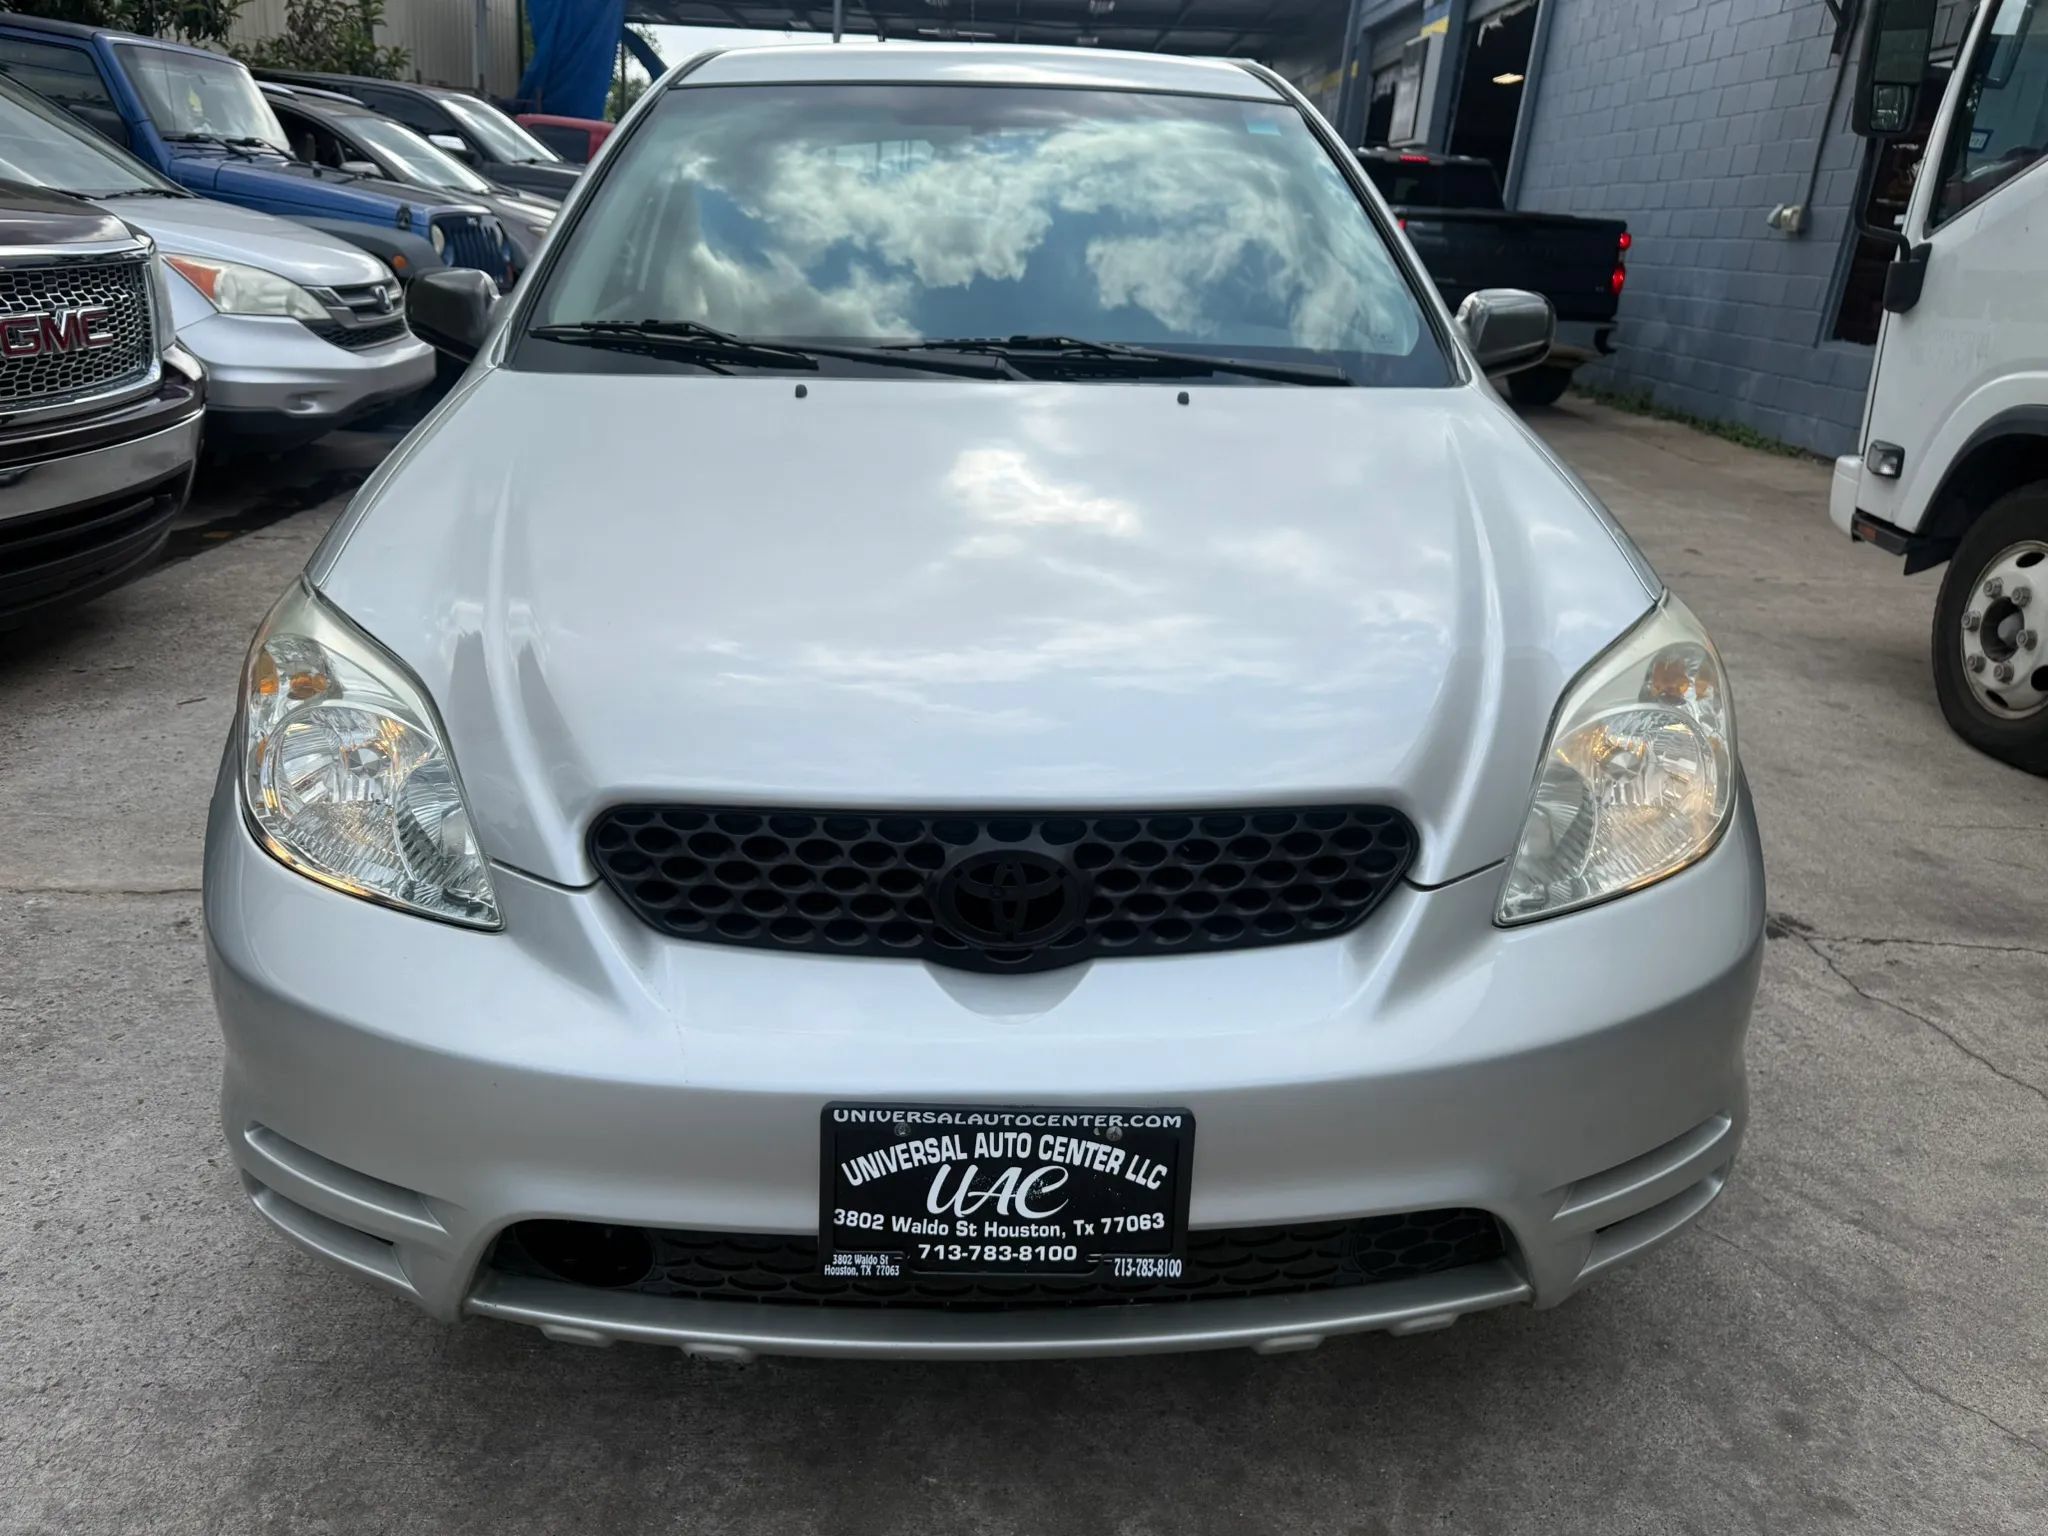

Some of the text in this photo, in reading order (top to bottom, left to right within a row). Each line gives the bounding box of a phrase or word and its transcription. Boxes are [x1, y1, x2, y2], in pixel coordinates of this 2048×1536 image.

[0, 306, 113, 358] GMC
[833, 1109, 1182, 1128] UNIVERSALAUTOCENTER.COM
[841, 1131, 1168, 1191] UNIVERSAL AUTO CENTER LLC
[926, 1163, 1069, 1219] UAC
[833, 1208, 1165, 1240] 3802 Waldo St Houston, Tx 77063
[832, 1254, 889, 1266] 3802 Waldo St
[918, 1244, 1078, 1262] 713-783-8100
[824, 1265, 900, 1277] Houston, TX 77063
[1114, 1257, 1182, 1278] 713-783-8100
